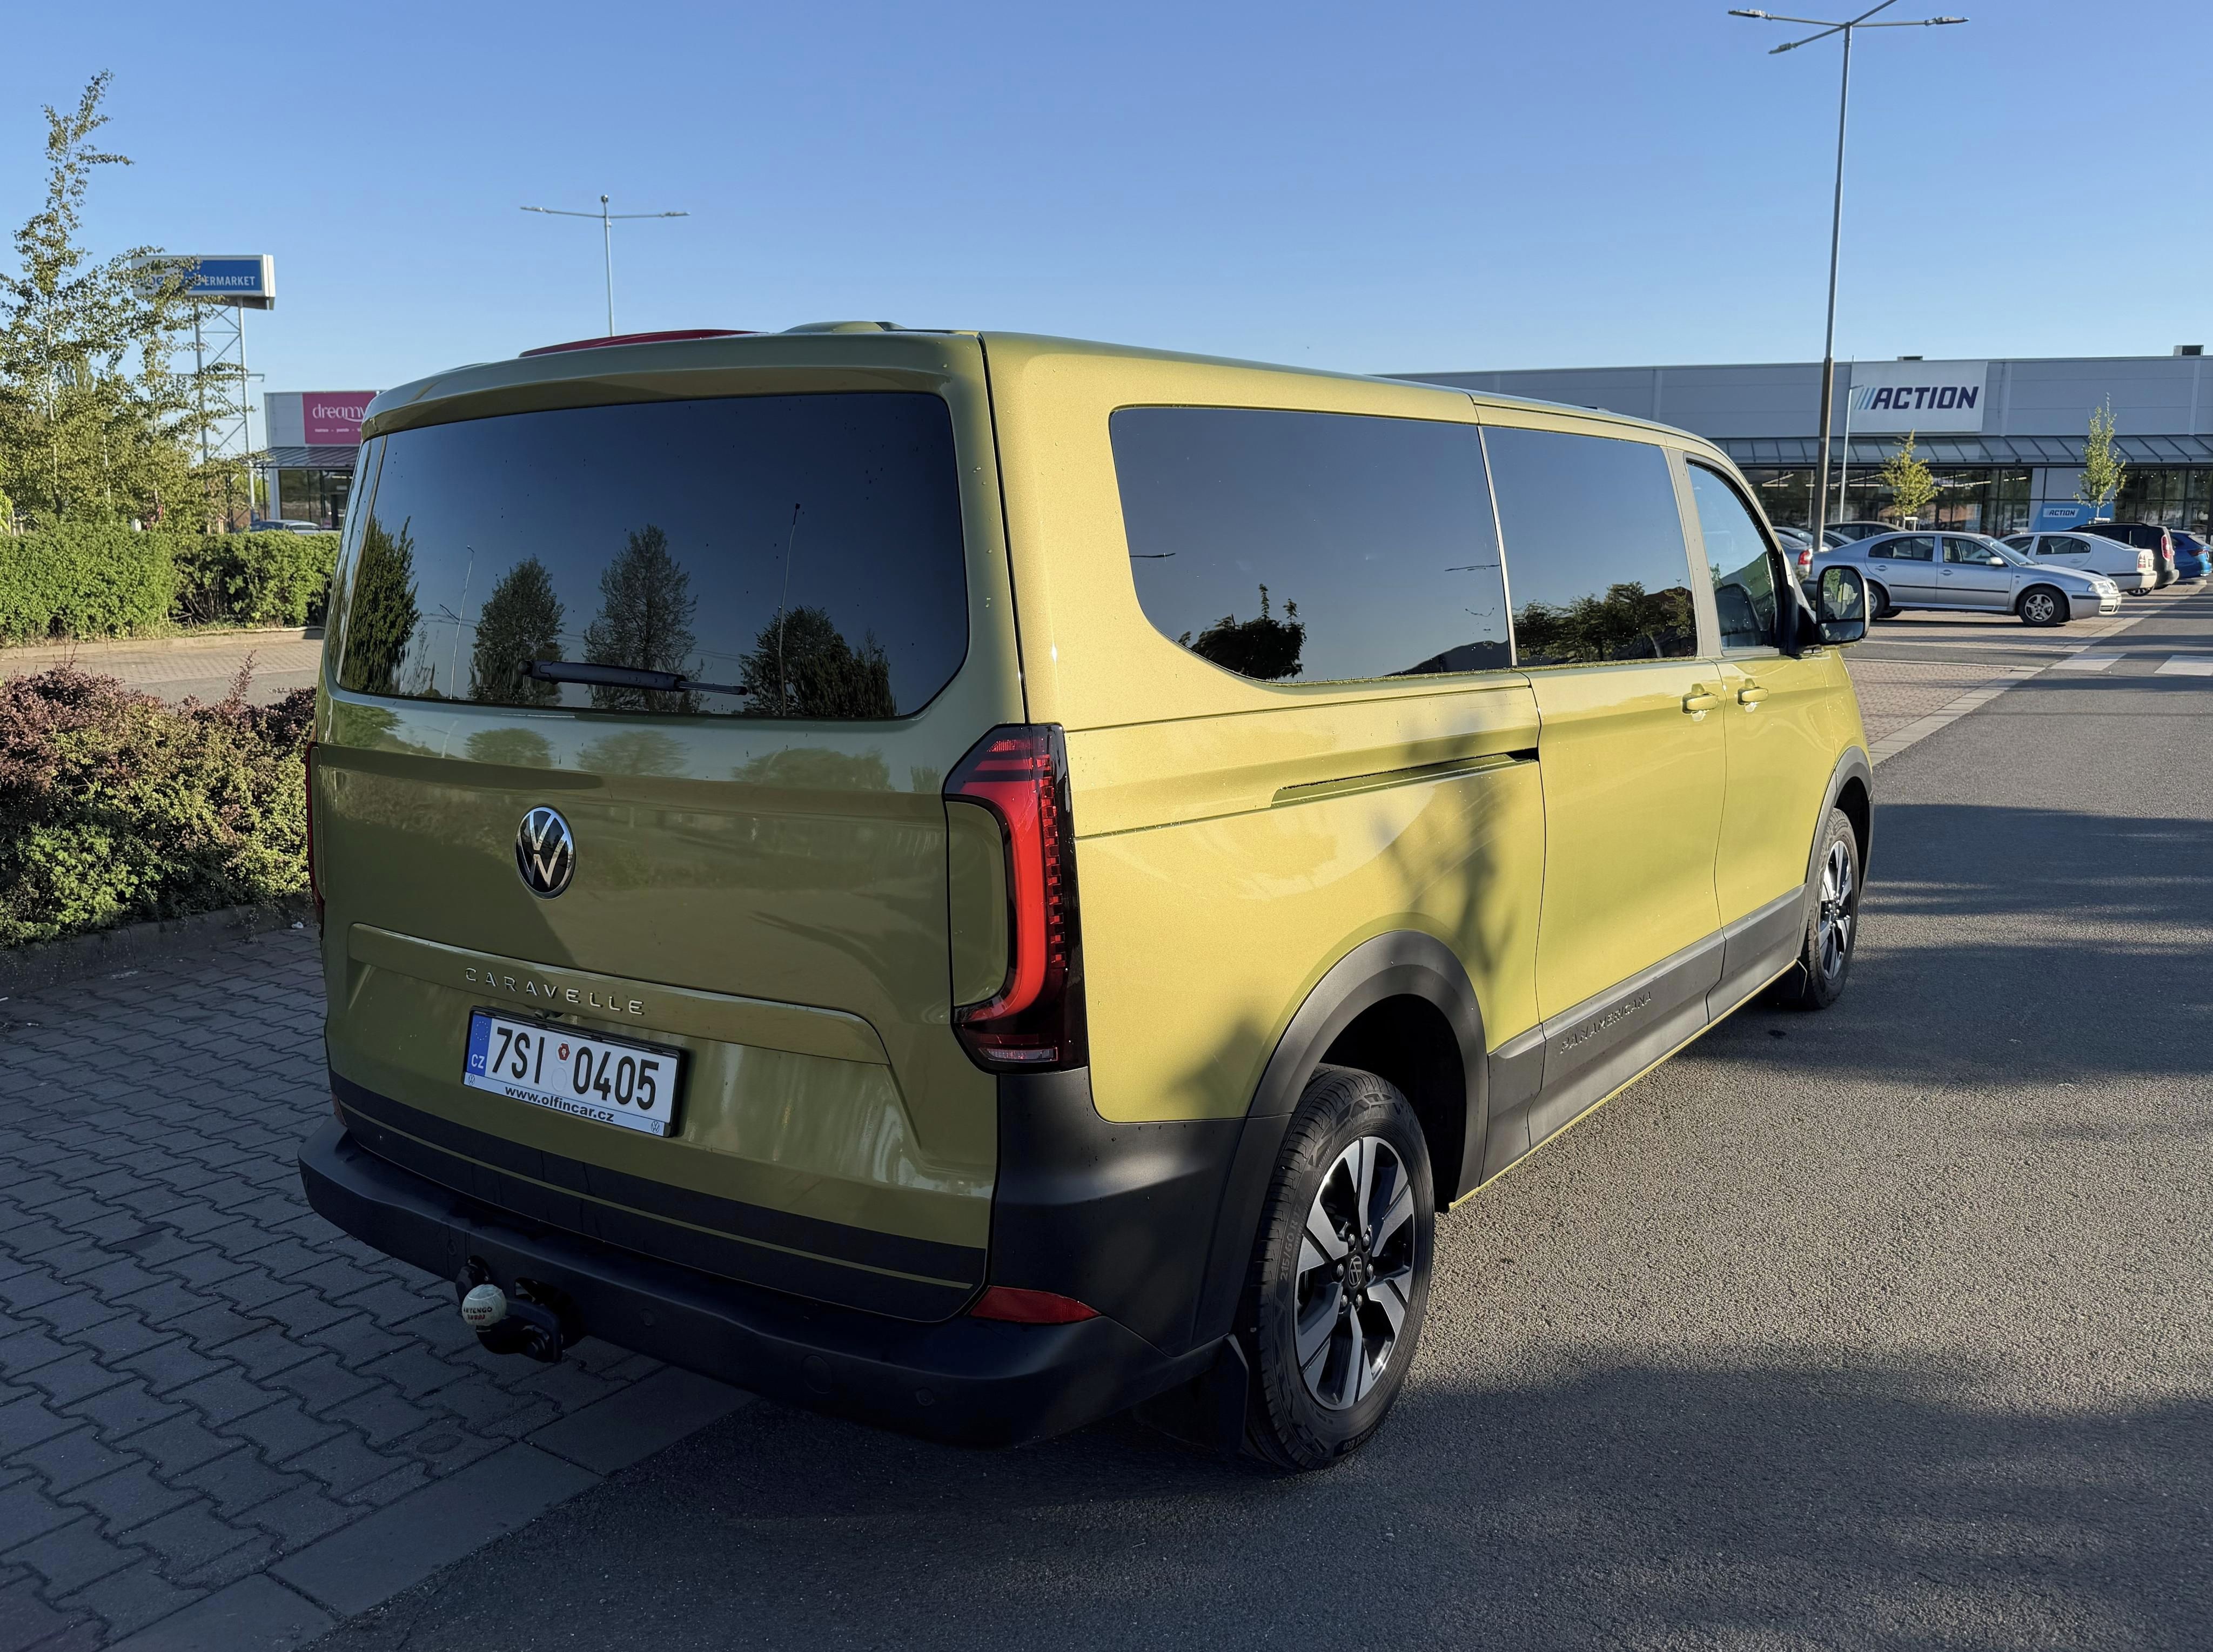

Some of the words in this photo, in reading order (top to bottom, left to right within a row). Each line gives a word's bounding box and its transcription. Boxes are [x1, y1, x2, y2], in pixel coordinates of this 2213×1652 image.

[187, 276, 256, 286] ERMARKET
[1870, 387, 1979, 409] ACTION
[466, 968, 645, 1016] CARAVELLE
[471, 1053, 485, 1069] CZ
[492, 1026, 545, 1085] 7SI
[573, 1046, 659, 1110] 0405
[505, 1086, 614, 1123] www.olfincar.cz
[1280, 1232, 1295, 1281] 215/60
